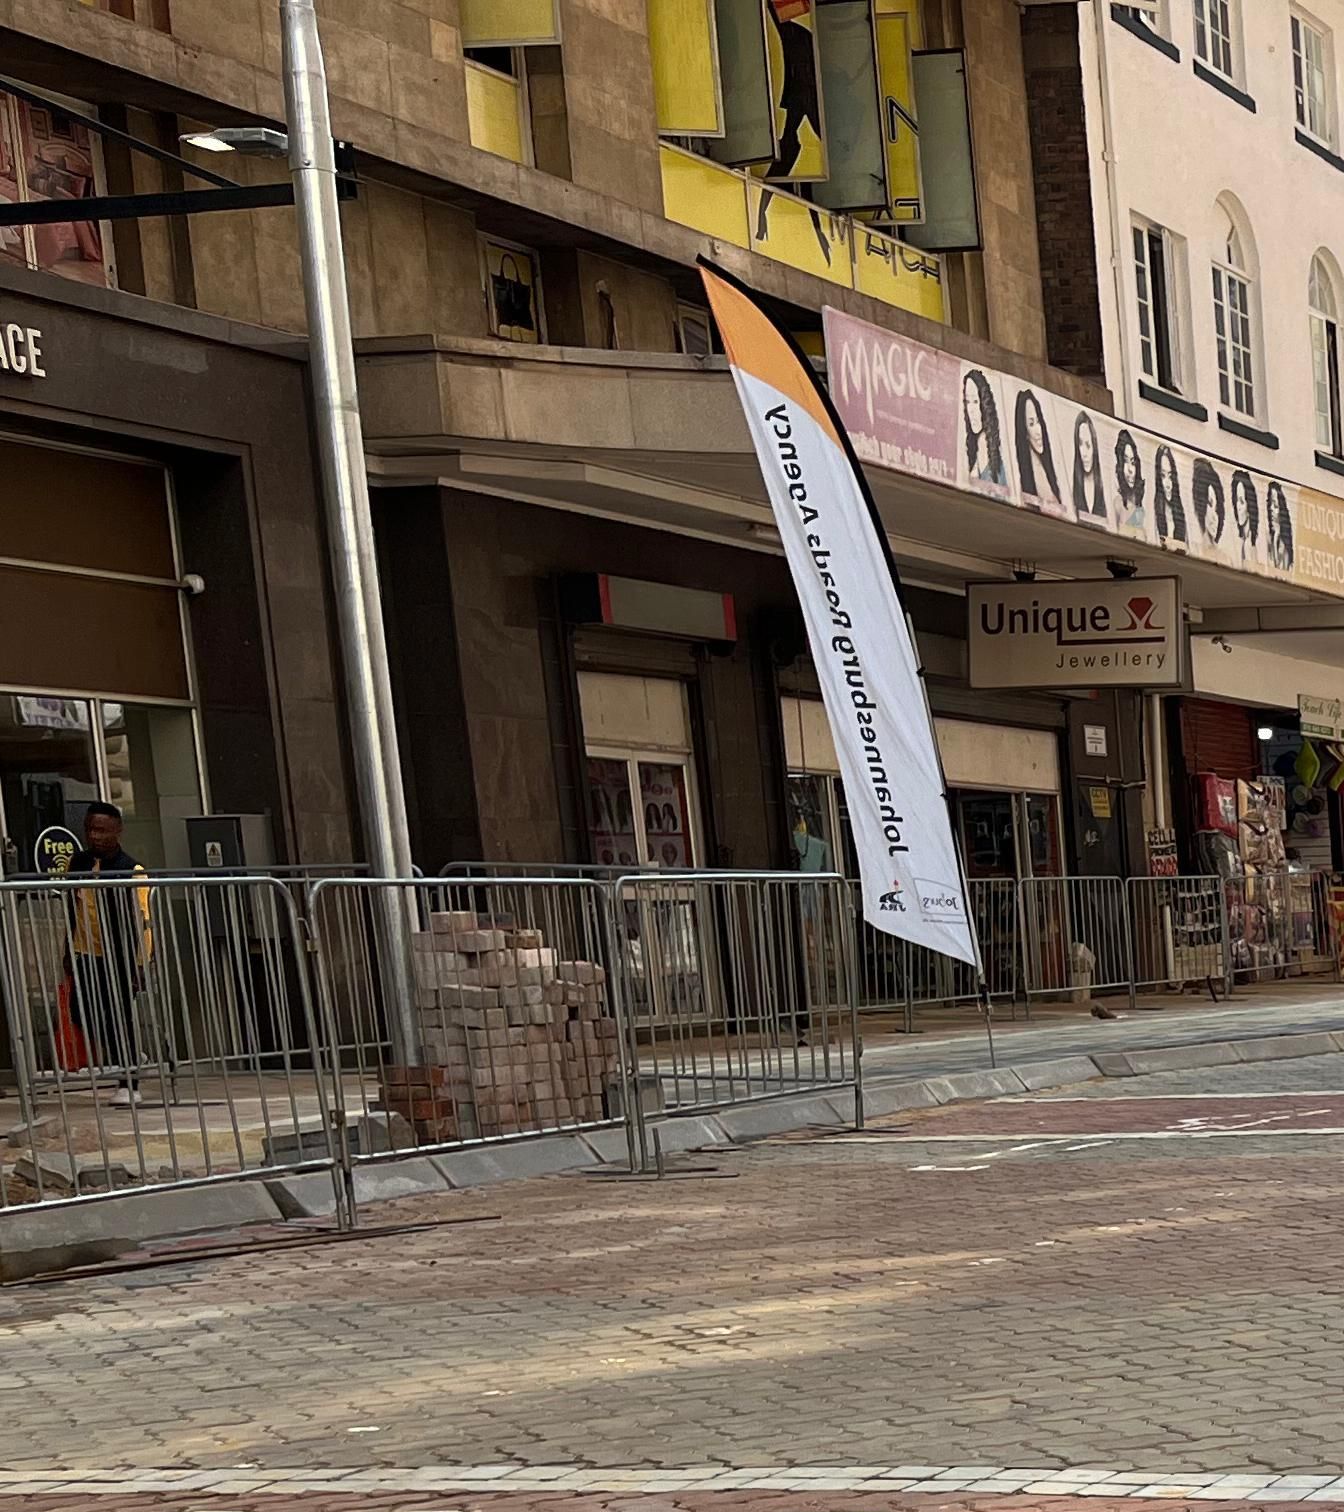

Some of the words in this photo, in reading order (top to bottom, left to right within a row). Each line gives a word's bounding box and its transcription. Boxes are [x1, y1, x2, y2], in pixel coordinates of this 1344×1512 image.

[840, 337, 932, 426] MAGIC
[980, 600, 1110, 646] Unique
[1056, 651, 1166, 669] Jewellery
[43, 838, 74, 854] Free
